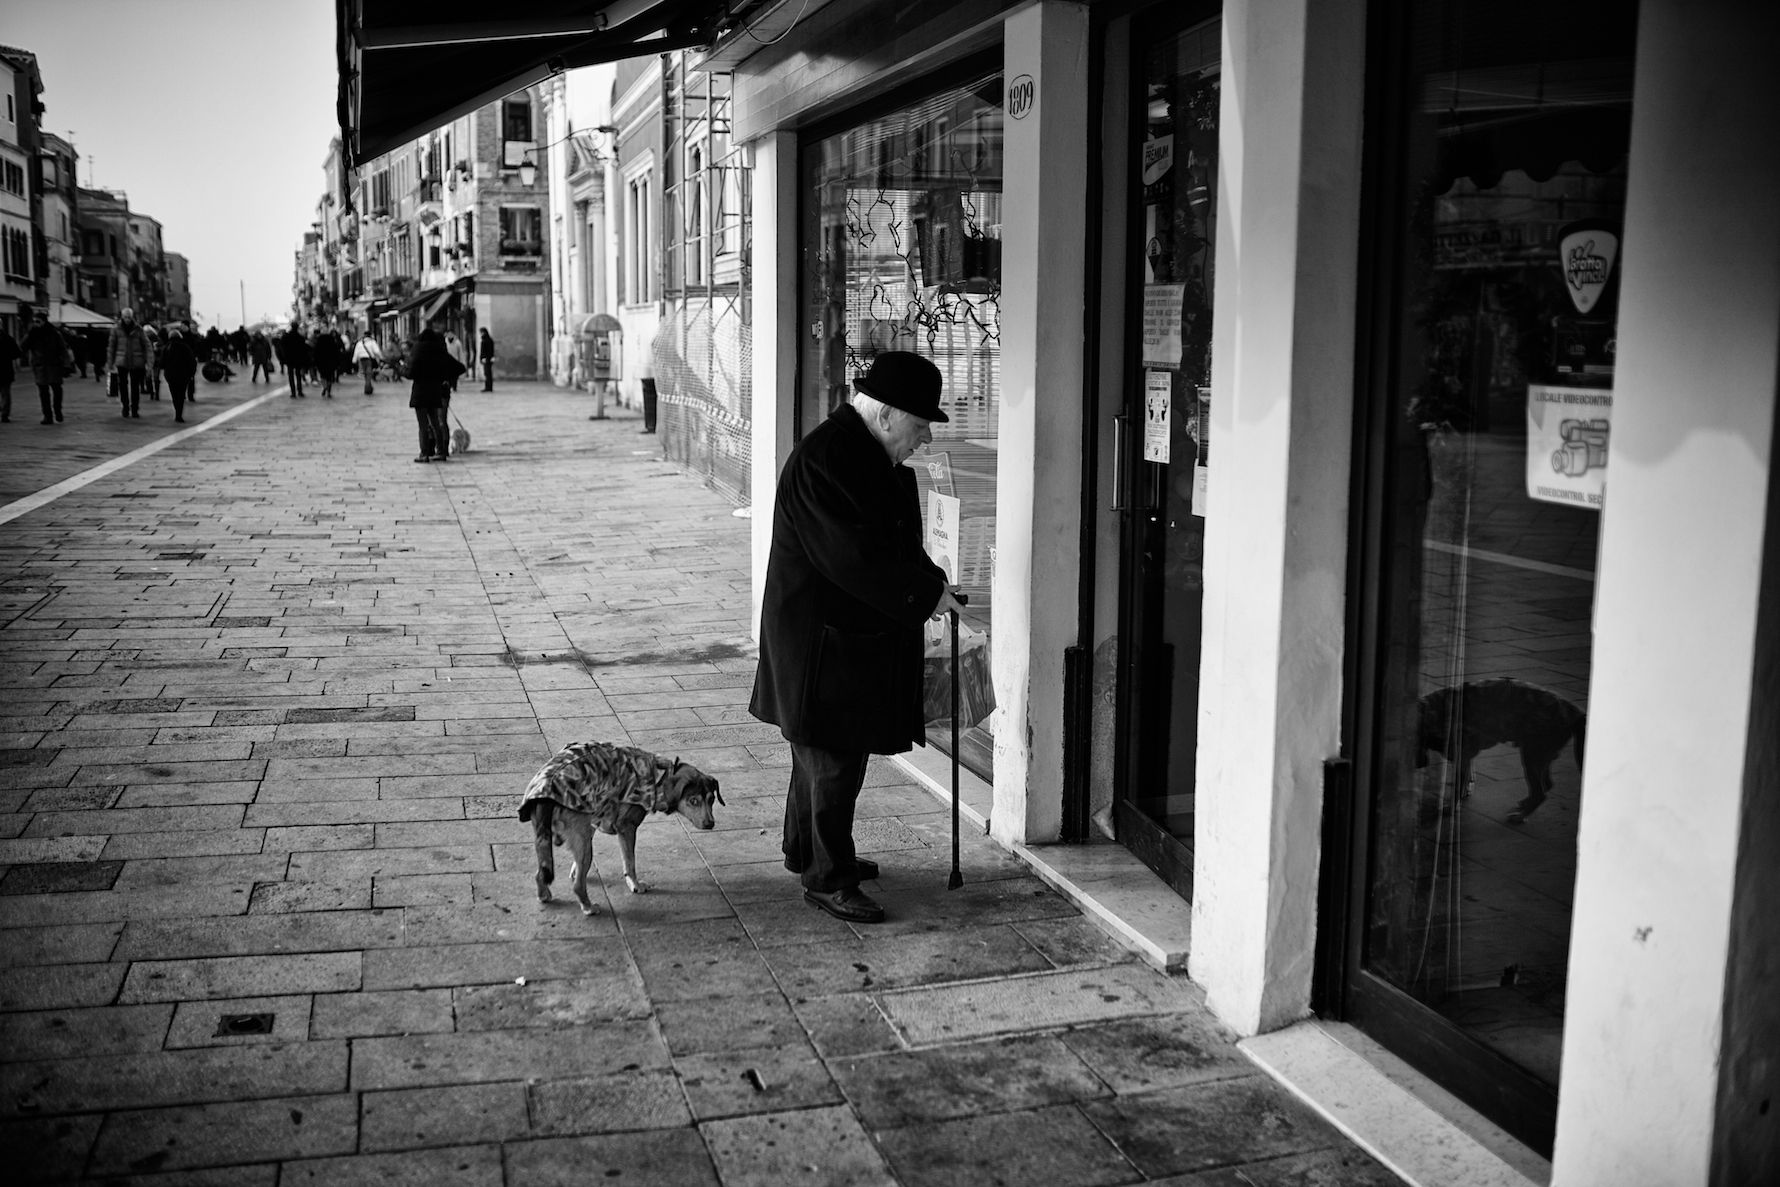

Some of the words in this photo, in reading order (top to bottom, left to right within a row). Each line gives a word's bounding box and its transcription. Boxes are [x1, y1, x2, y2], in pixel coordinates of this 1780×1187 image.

[1009, 81, 1034, 115] 1809
[1146, 145, 1169, 161] PREMIUM
[1570, 257, 1602, 270] Gratta
[1535, 391, 1562, 403] LOCALE
[1537, 486, 1586, 502] VIDEOCONTROL
